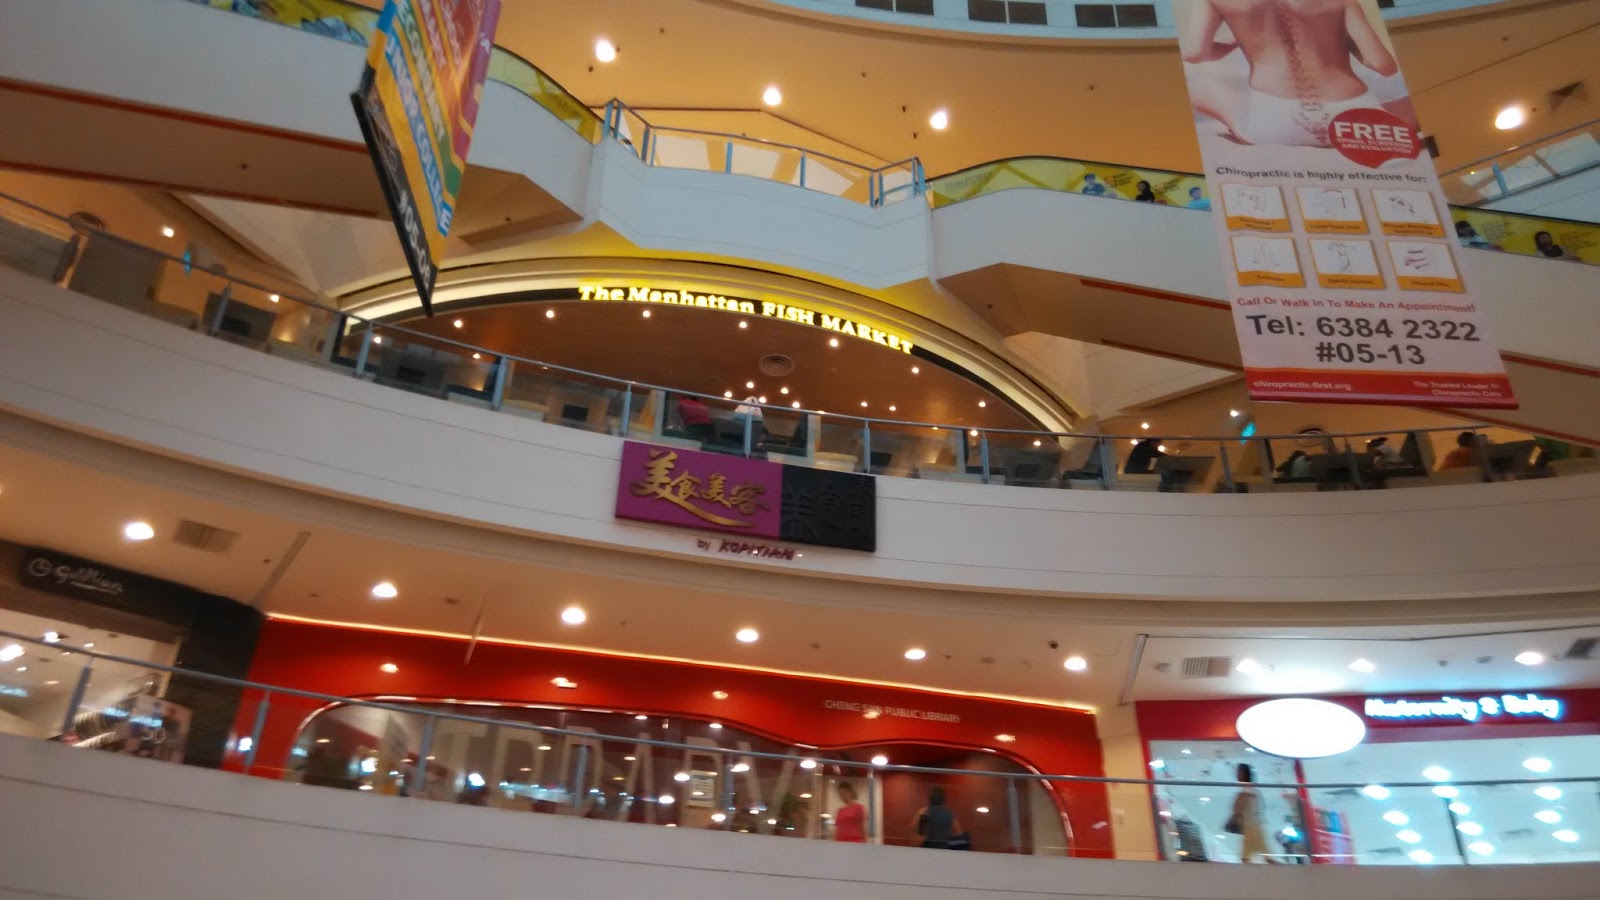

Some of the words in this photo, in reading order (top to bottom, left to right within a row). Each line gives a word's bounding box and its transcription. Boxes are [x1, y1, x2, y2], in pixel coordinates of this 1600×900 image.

[1333, 120, 1413, 144] FREE
[1361, 144, 1412, 154] EVALUATION
[1215, 166, 1291, 179] Chiropractic
[1292, 170, 1304, 179] is
[1307, 170, 1344, 181] highly
[1348, 171, 1403, 181] effective
[1405, 174, 1428, 184] for:
[1236, 298, 1261, 307] Call
[1263, 297, 1277, 305] Or
[1280, 298, 1310, 307] Walk
[1312, 299, 1324, 307] In
[1327, 299, 1341, 308] To
[1344, 300, 1375, 309] Make
[1378, 301, 1395, 309] An
[1397, 302, 1476, 313] Appointment!
[577, 285, 625, 302] The
[628, 285, 755, 315] Manhattan
[761, 301, 816, 327] FISH
[820, 313, 914, 355] MARKET
[1246, 314, 1305, 337] Tel:
[1316, 316, 1393, 339] 6384
[1403, 319, 1480, 342] 2322
[1315, 341, 1426, 365] #05-13
[1253, 380, 1352, 392] chiropractic-first.org
[1431, 389, 1481, 397] Chiropractic
[824, 699, 861, 712] CHENG
[861, 703, 883, 716] SAN
[884, 706, 921, 719] PUBLIC
[922, 710, 962, 724] LIBRARY
